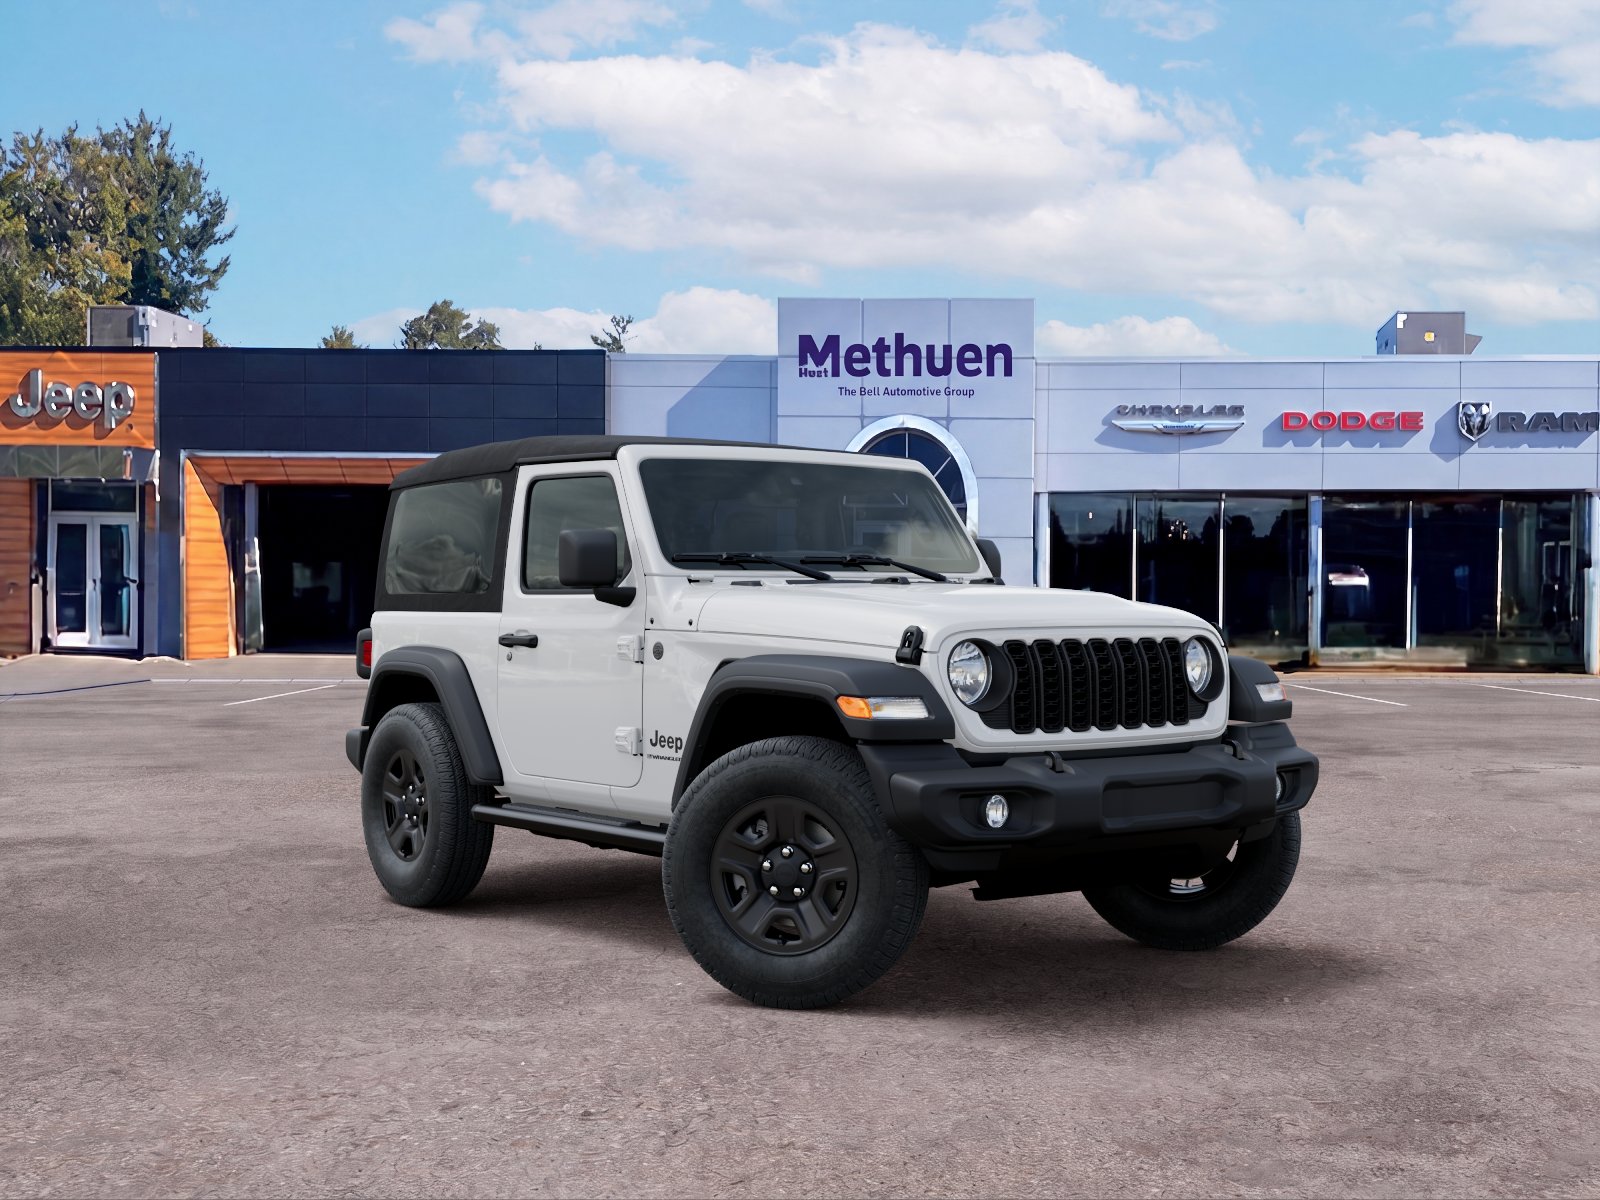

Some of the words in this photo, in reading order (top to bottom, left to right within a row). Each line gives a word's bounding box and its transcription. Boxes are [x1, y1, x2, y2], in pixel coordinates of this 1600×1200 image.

[799, 333, 1012, 377] Methuen
[9, 368, 135, 429] Jeep
[838, 386, 857, 396] The
[859, 386, 881, 396] Bell
[883, 386, 941, 396] Automotive
[944, 386, 975, 398] Group
[1282, 411, 1424, 431] DODGE
[1497, 411, 1600, 432] RAM
[649, 729, 683, 754] Jeep
